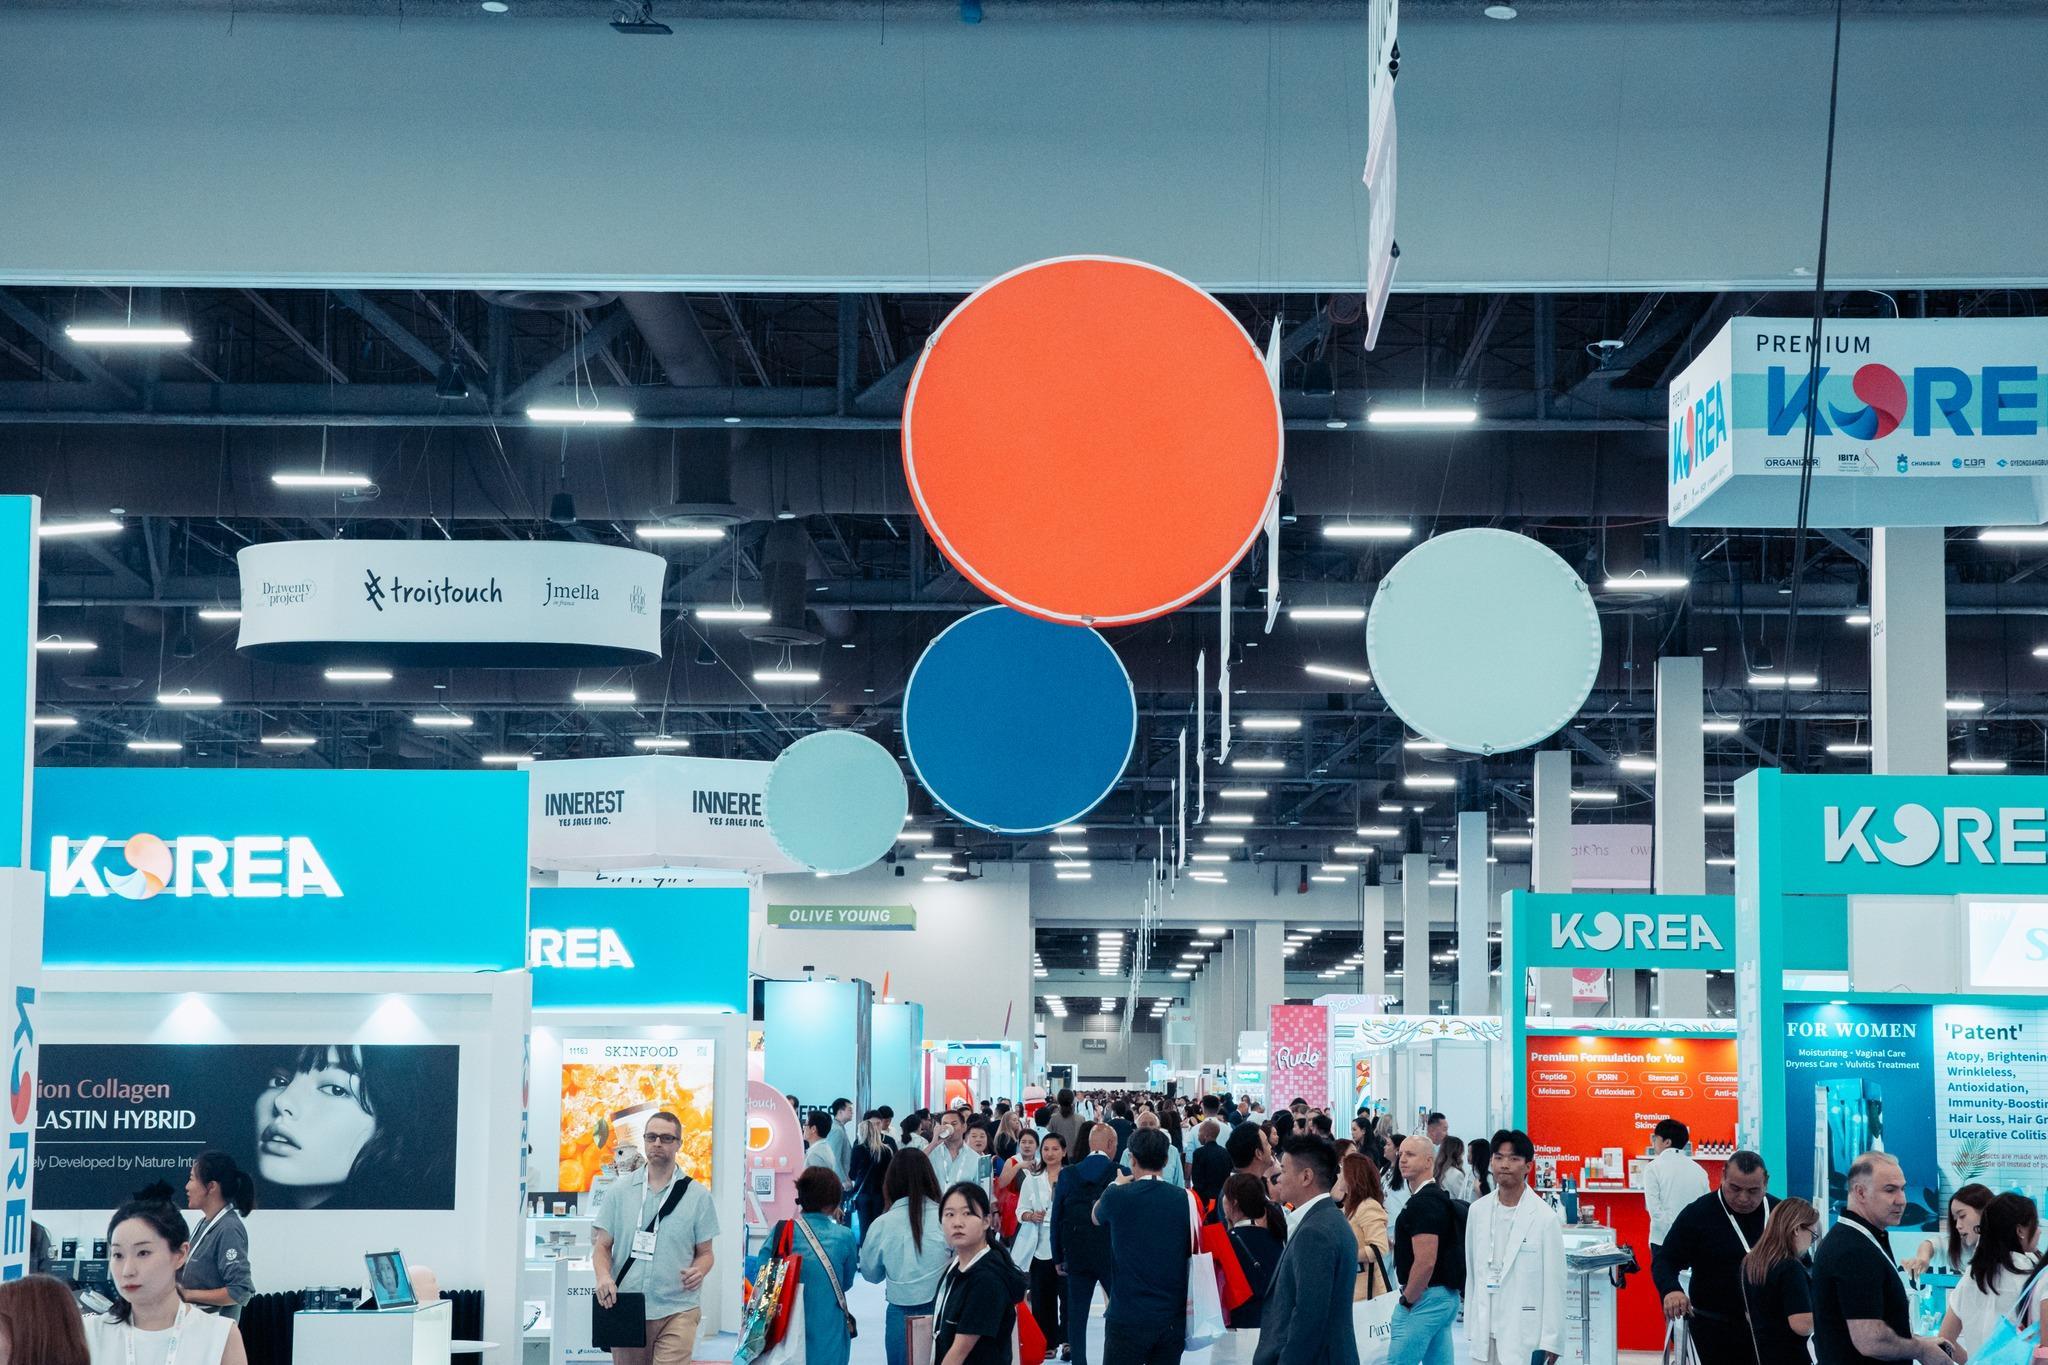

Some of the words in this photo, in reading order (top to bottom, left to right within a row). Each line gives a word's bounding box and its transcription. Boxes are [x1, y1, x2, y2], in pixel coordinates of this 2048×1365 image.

[1673, 380, 1727, 485] KOREA
[1838, 454, 1860, 462] IBITA
[390, 576, 503, 606] troistouch
[543, 577, 600, 607] jmella
[545, 790, 625, 816] INNEREST
[692, 790, 762, 816] INNERE
[559, 818, 571, 827] YES
[573, 817, 593, 826] SALES
[709, 817, 723, 826] YES
[725, 817, 748, 827] SALES
[50, 832, 344, 900] KOREA
[789, 909, 834, 922] OLIVE
[838, 909, 891, 922] YOUNG
[1551, 911, 1724, 951] KOREA
[530, 927, 636, 969] REA
[1786, 1022, 1829, 1037] FOR
[1834, 1022, 1918, 1038] WOMEN
[1945, 1023, 2023, 1041] 'Patent'
[605, 1046, 679, 1058] SKINFOOD
[1531, 1052, 1578, 1062] Premium
[1580, 1052, 1644, 1062] Formulation
[1646, 1053, 1662, 1063] for
[1664, 1053, 1684, 1063] You
[1798, 1049, 1848, 1059] Moisturizing
[1855, 1049, 1886, 1059] Vaginal
[1887, 1050, 1907, 1058] Care
[1947, 1052, 1984, 1063] Atopy,
[1987, 1052, 2048, 1064] Brightenin
[1786, 1060, 1818, 1069] Dryness
[1819, 1060, 1838, 1068] Care
[1845, 1060, 1876, 1069] Vulvitis
[1878, 1061, 1920, 1069] Treatment
[1540, 1072, 1568, 1083] Peptide
[1648, 1074, 1679, 1082] Stemcell
[1947, 1067, 2016, 1079] Wrinkleless,
[37, 1079, 71, 1099] ion
[77, 1078, 170, 1104] Collagen
[1538, 1087, 1571, 1096] Melasma
[1594, 1088, 1635, 1097] Antioxidant
[1661, 1089, 1678, 1097] Cica
[1947, 1083, 2029, 1095] Antioxidation,
[35, 1110, 107, 1129] LASTIN
[113, 1110, 197, 1130] HYBRID
[1635, 1113, 1671, 1121] Premium
[1950, 1114, 1973, 1124] Hair
[1977, 1114, 2005, 1125] Loss,
[2008, 1115, 2032, 1125] Hair
[2, 985, 36, 1283] KORE
[1950, 1129, 2007, 1140] Ulcerative
[2011, 1130, 2047, 1141] Colitis
[1533, 1145, 1561, 1154] Unique
[49, 1155, 115, 1170] Developed
[117, 1155, 132, 1170] by
[134, 1156, 176, 1168] Nature
